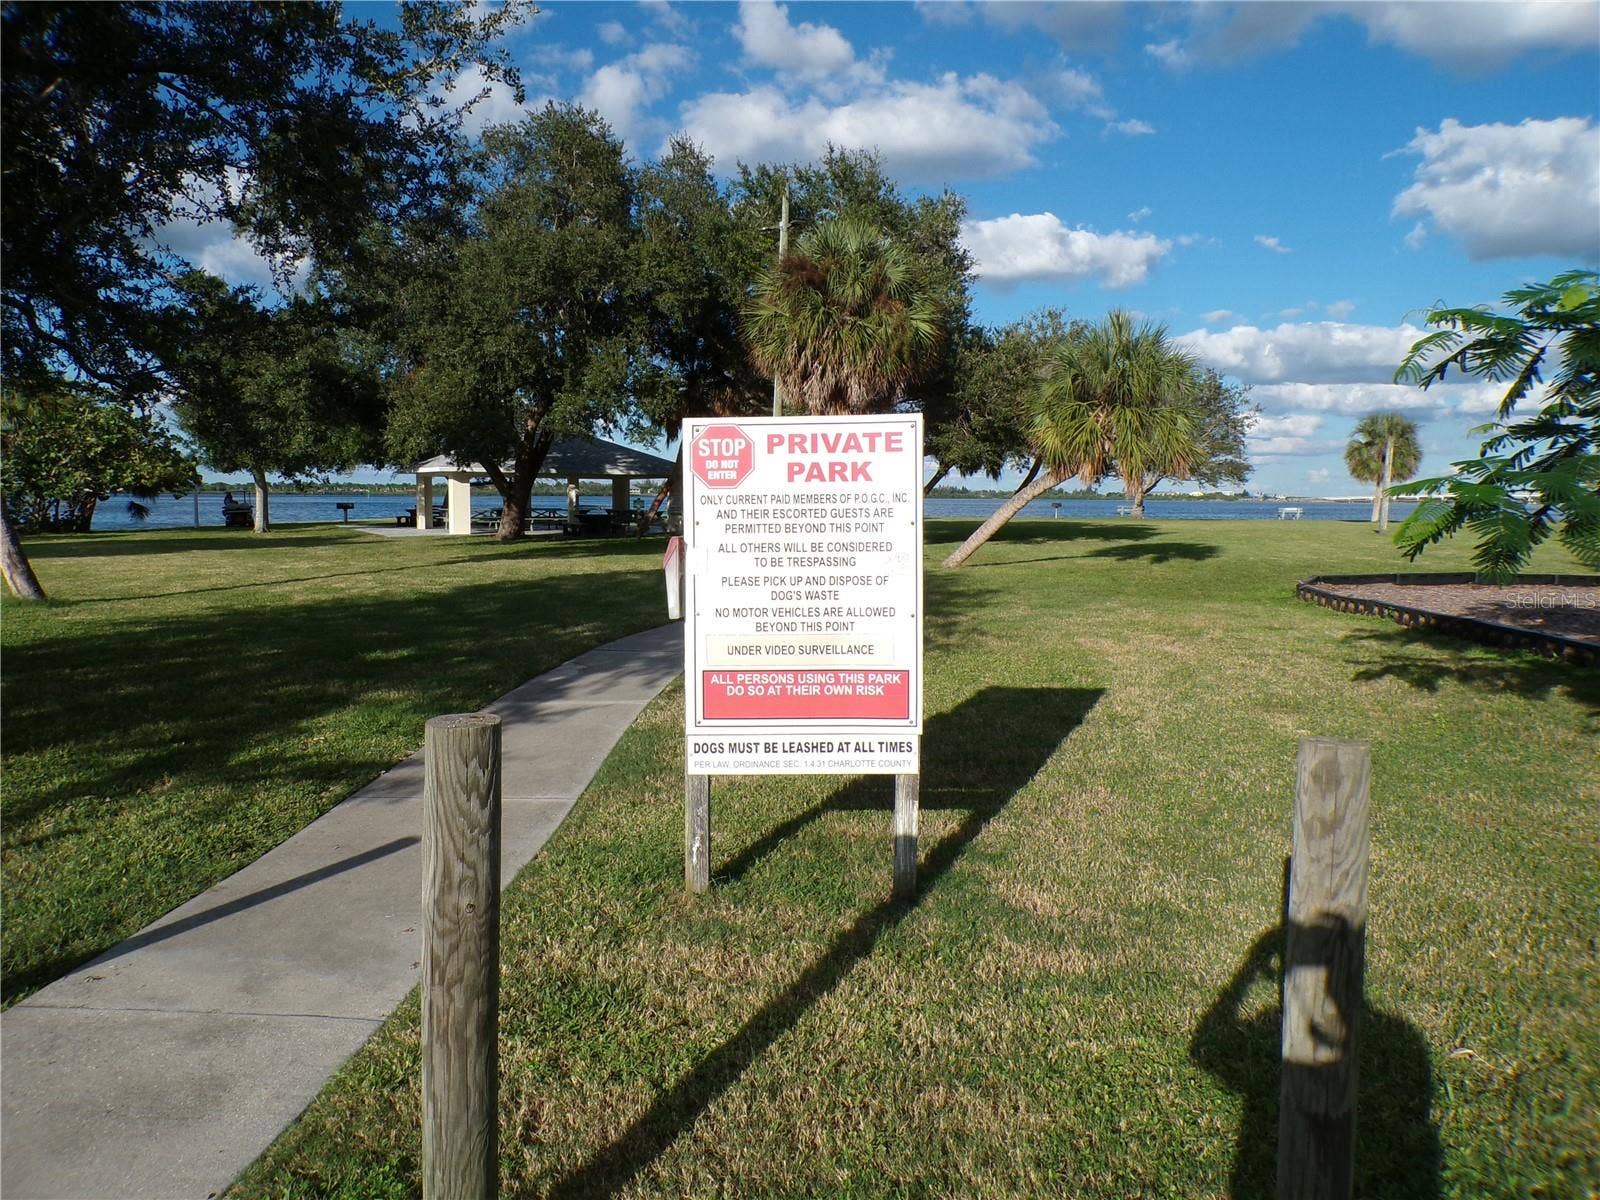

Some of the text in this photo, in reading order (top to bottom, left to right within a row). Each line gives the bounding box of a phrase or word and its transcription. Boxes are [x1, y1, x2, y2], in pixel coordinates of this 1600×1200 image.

[698, 438, 746, 457] STOP
[767, 432, 903, 454] PRIVATE
[705, 460, 739, 469] DO NOT
[708, 471, 737, 479] ENTER
[787, 461, 872, 482] PARK
[700, 495, 723, 505] ONLY
[725, 495, 768, 504] CURRENT
[771, 494, 790, 504] PAID
[793, 494, 837, 504] MEMBERS
[839, 494, 852, 504] OF
[716, 508, 894, 519] AND THEIR ESCORTED GUESTS ARE
[725, 522, 884, 534] PERMITTED BEYOND THIS POINT
[718, 542, 892, 553] ALL OTHERS WILL BE CONSIDERED
[755, 557, 856, 567] TO BE TRESPASSING
[722, 576, 889, 587] PLEASE PICK UP AND DISPOSE OF
[771, 590, 839, 601] DOG'S WASTE
[715, 607, 896, 618] NO MOTOR VEHICLES ARE ALLOWED
[755, 622, 855, 632] BEYOND THIS POINT
[727, 645, 874, 655] UNDER VIDEO SURVEILLANCE
[711, 674, 901, 684] ALL PERSONS USING THIS PARK
[726, 685, 884, 696] DO SO AT THEIR OWN RISK
[694, 741, 913, 754] DOGS MUST BE LEASHED AT ALL TIMES
[733, 760, 780, 768] ORDINANCE
